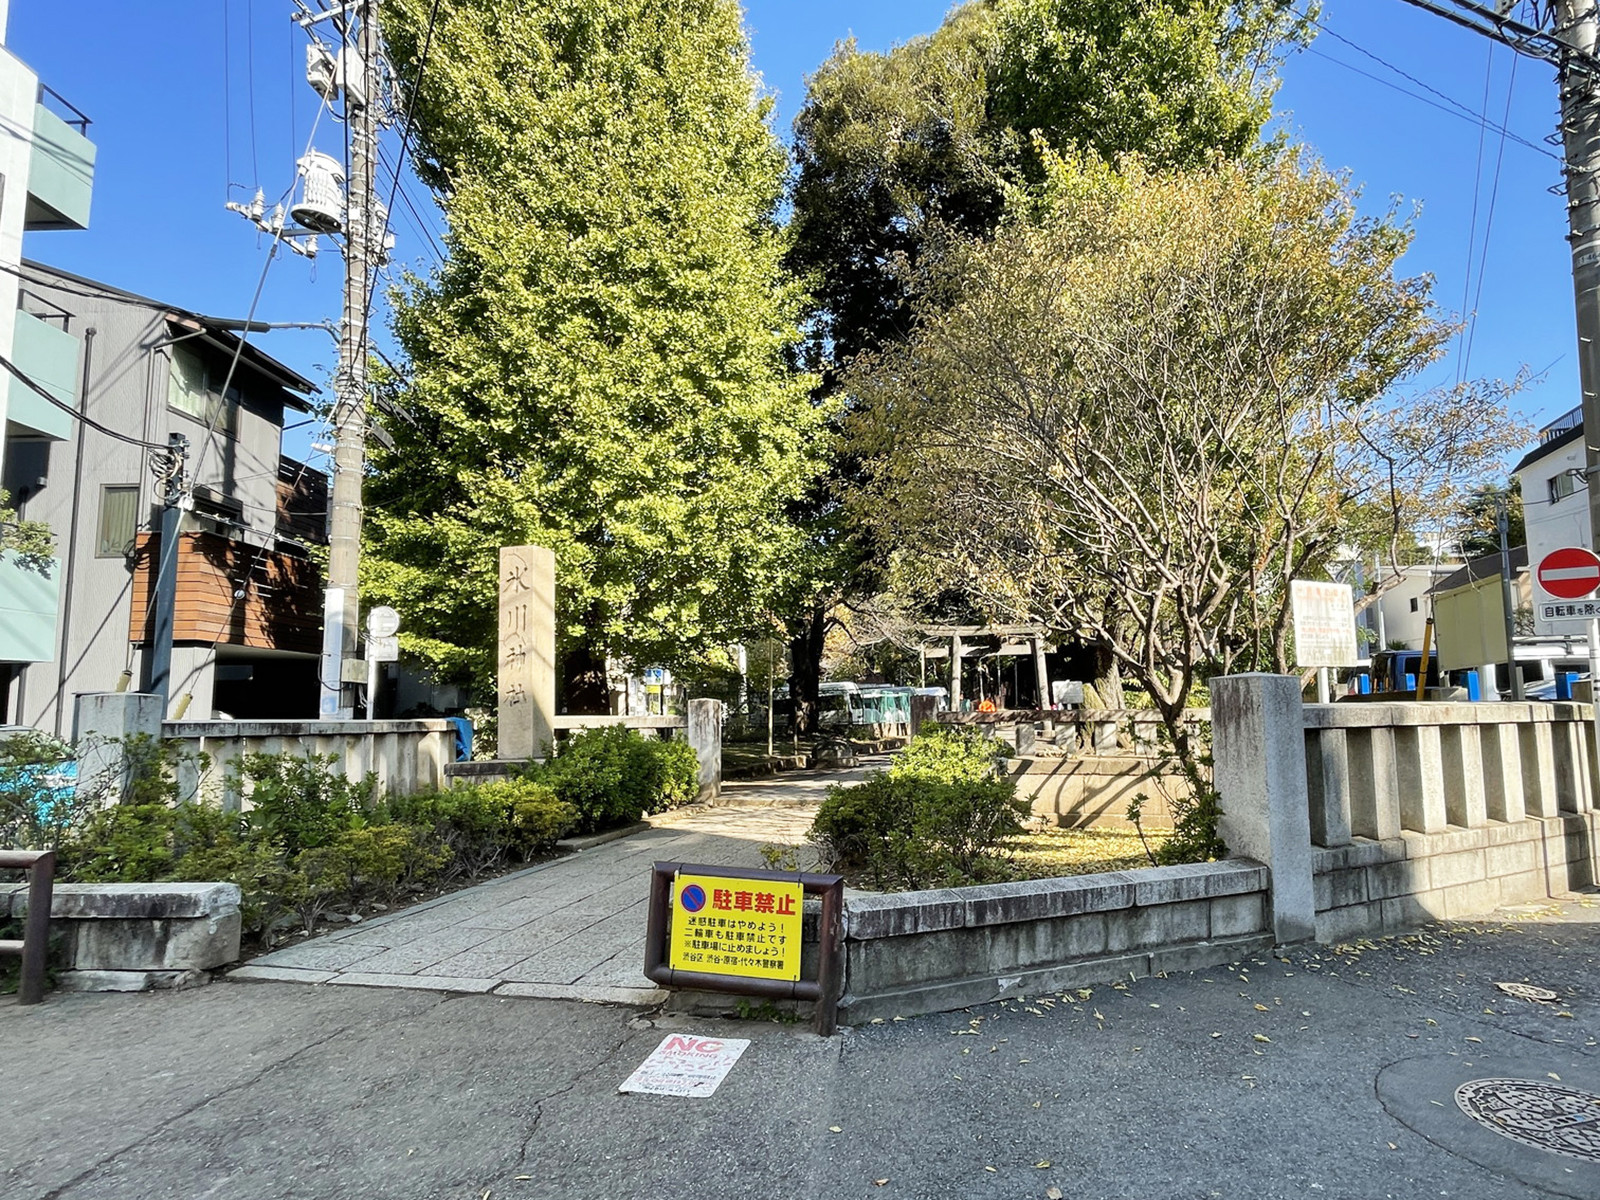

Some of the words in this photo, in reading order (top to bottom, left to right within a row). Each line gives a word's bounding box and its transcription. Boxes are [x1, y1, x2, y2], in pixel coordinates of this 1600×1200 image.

[503, 566, 530, 707] 氷川神社
[714, 889, 796, 915] 駐車禁止
[684, 927, 786, 945] 二輪車も駐車禁止です
[682, 952, 704, 962] 渋谷区
